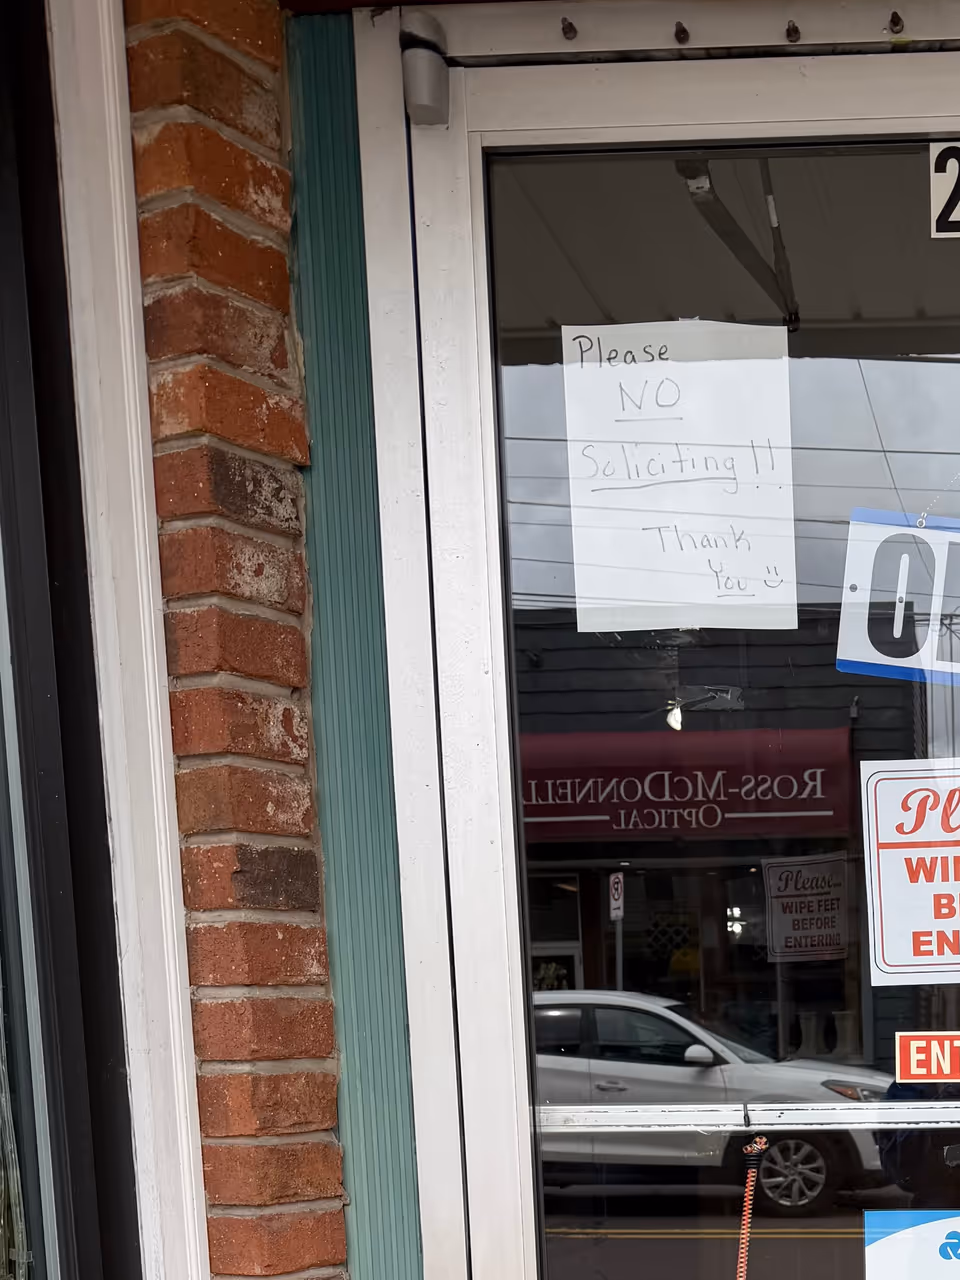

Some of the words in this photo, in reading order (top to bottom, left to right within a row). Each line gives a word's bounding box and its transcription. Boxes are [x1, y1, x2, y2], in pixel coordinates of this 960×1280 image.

[572, 335, 669, 368] Please
[619, 378, 681, 411] NO
[642, 525, 750, 552] Thank
[708, 559, 748, 591] You
[792, 916, 837, 932] BEFORE
